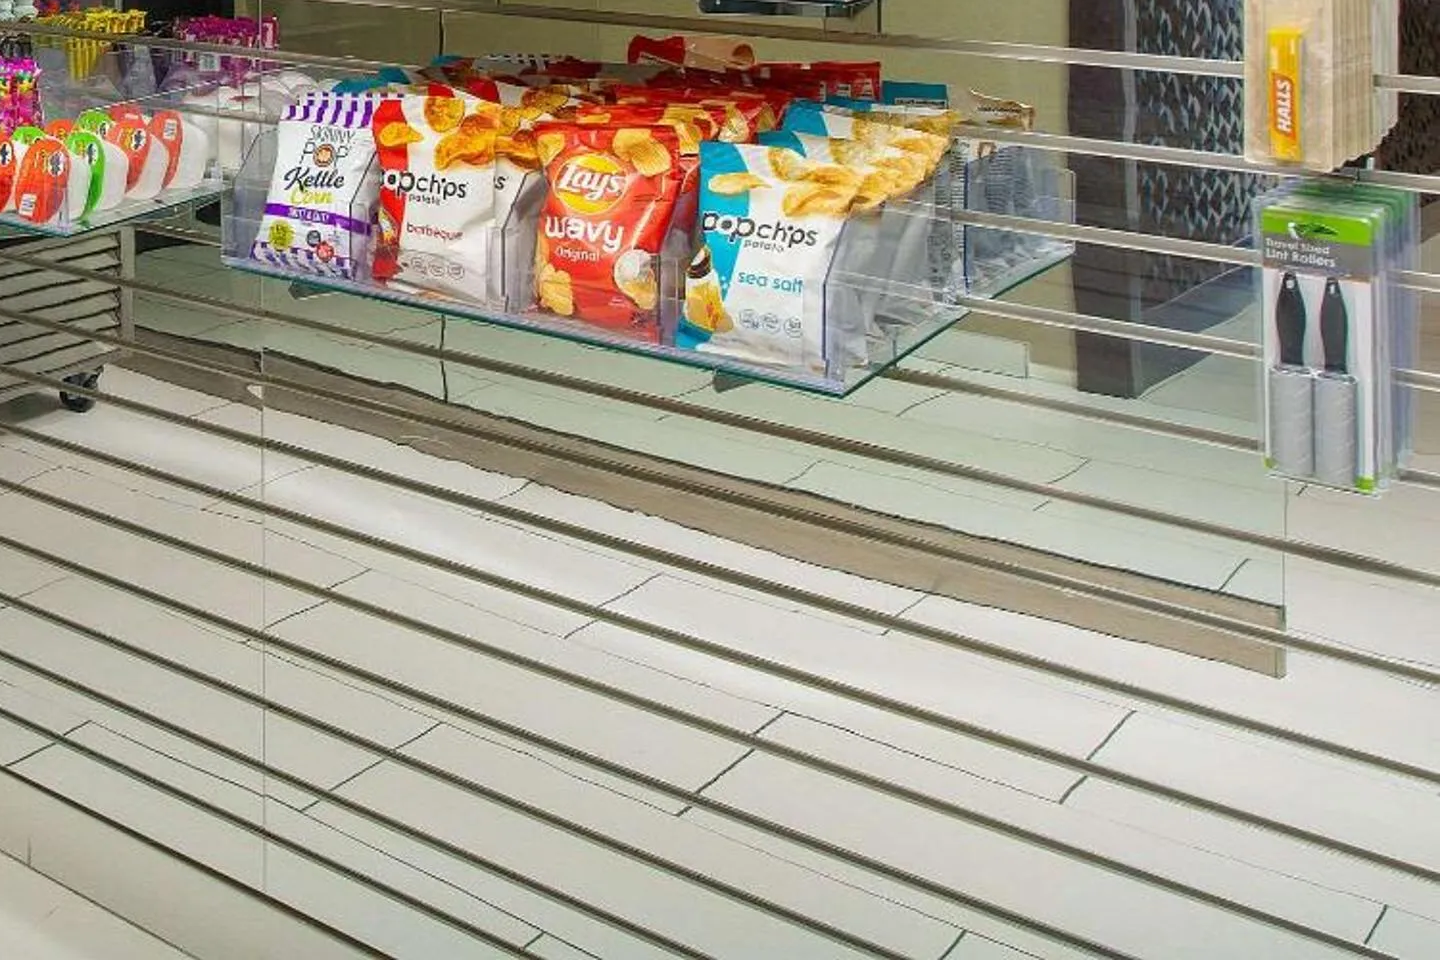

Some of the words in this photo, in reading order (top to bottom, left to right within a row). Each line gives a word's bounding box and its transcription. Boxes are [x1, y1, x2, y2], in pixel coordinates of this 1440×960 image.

[1276, 78, 1293, 134] HALLS
[284, 167, 345, 192] Kettle
[559, 163, 623, 201] Lay's
[545, 215, 625, 252] wavy
[703, 212, 819, 249] popchips
[555, 246, 601, 263] Original
[743, 239, 785, 253] potato
[1265, 248, 1289, 261] Lint
[1291, 251, 1336, 268] Rollers
[738, 271, 768, 287] sea
[772, 277, 804, 293] salt
